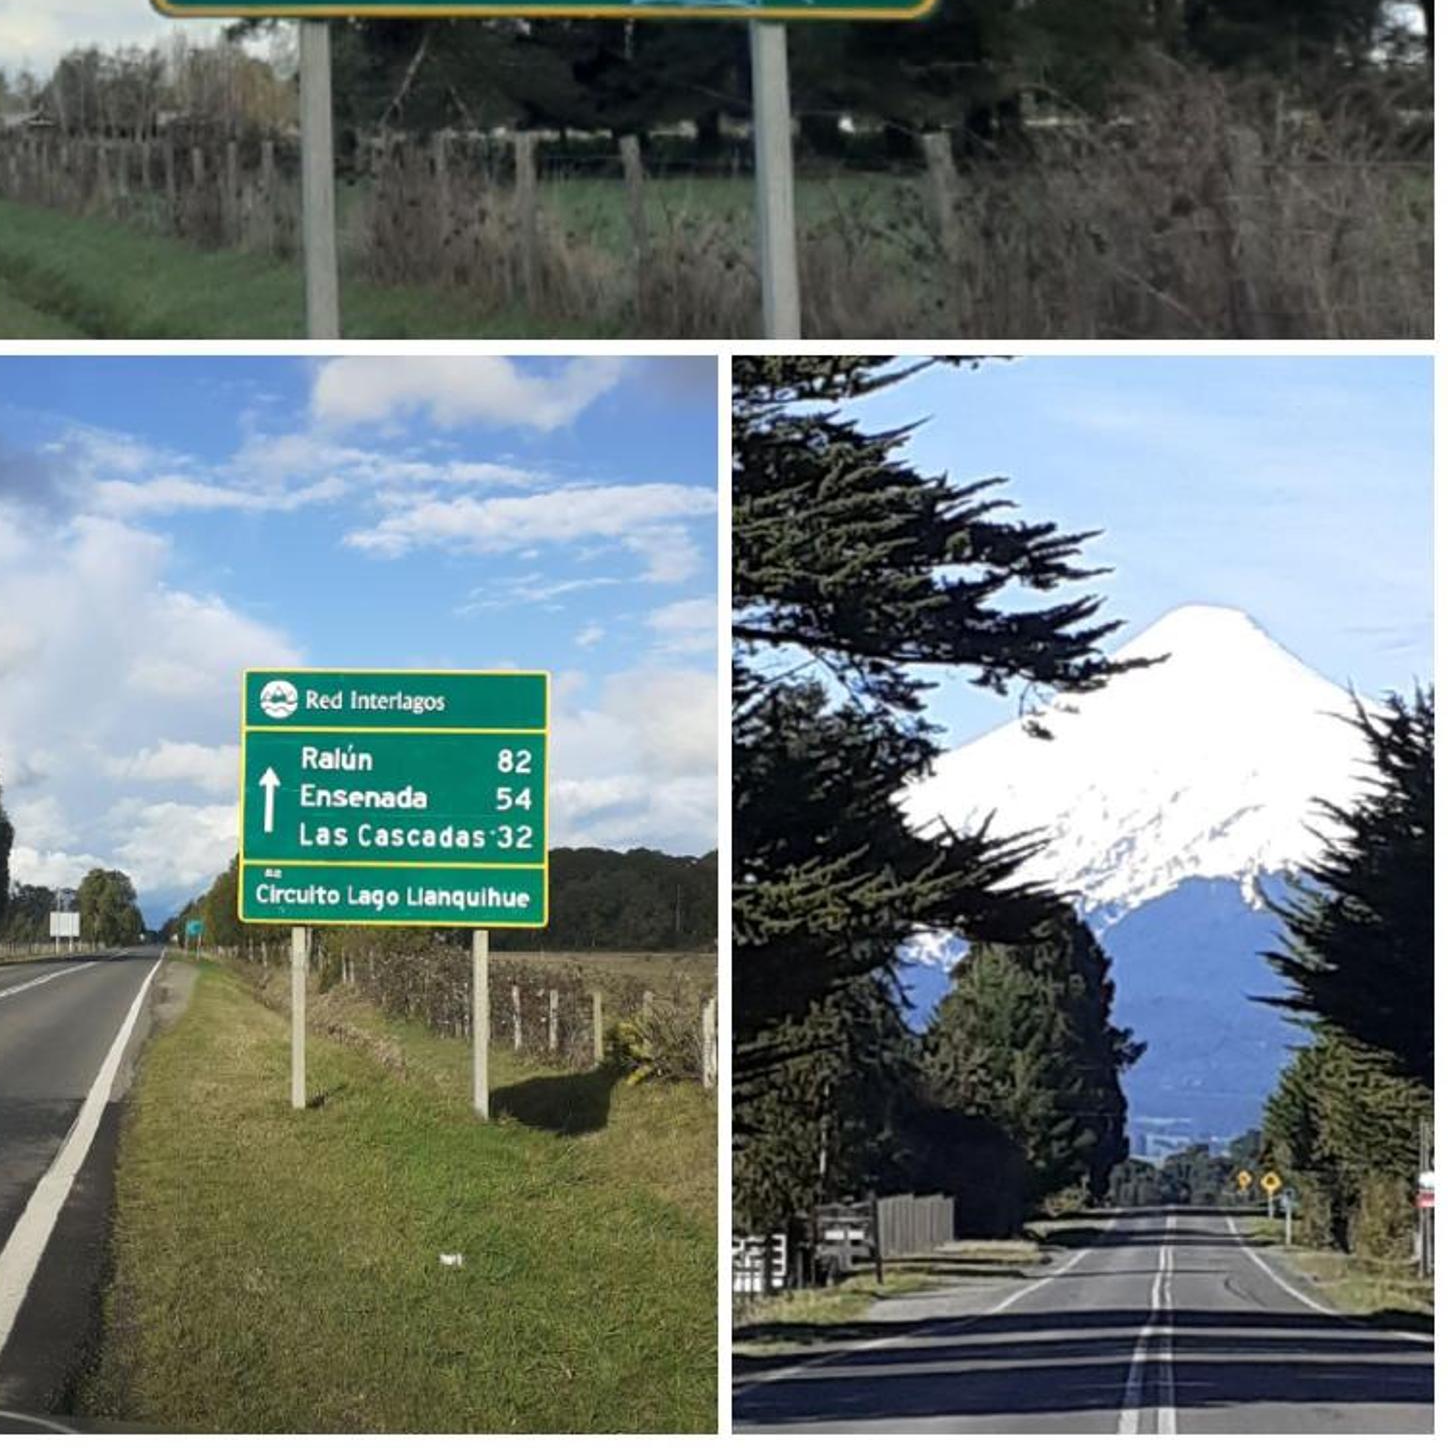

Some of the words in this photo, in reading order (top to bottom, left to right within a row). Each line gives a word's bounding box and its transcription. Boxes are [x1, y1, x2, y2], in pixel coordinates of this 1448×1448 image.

[305, 689, 343, 710] Red
[350, 690, 446, 715] Interlagos
[301, 744, 373, 771] Ralún
[497, 748, 532, 774] 82
[300, 783, 428, 809] Ensenada
[496, 786, 532, 811] 54
[299, 822, 349, 847] Las
[358, 823, 486, 848] Cascadas
[497, 825, 533, 849] 32
[255, 883, 341, 905] Circuito
[347, 885, 400, 912] Lago
[406, 887, 530, 911] Llanquihue
